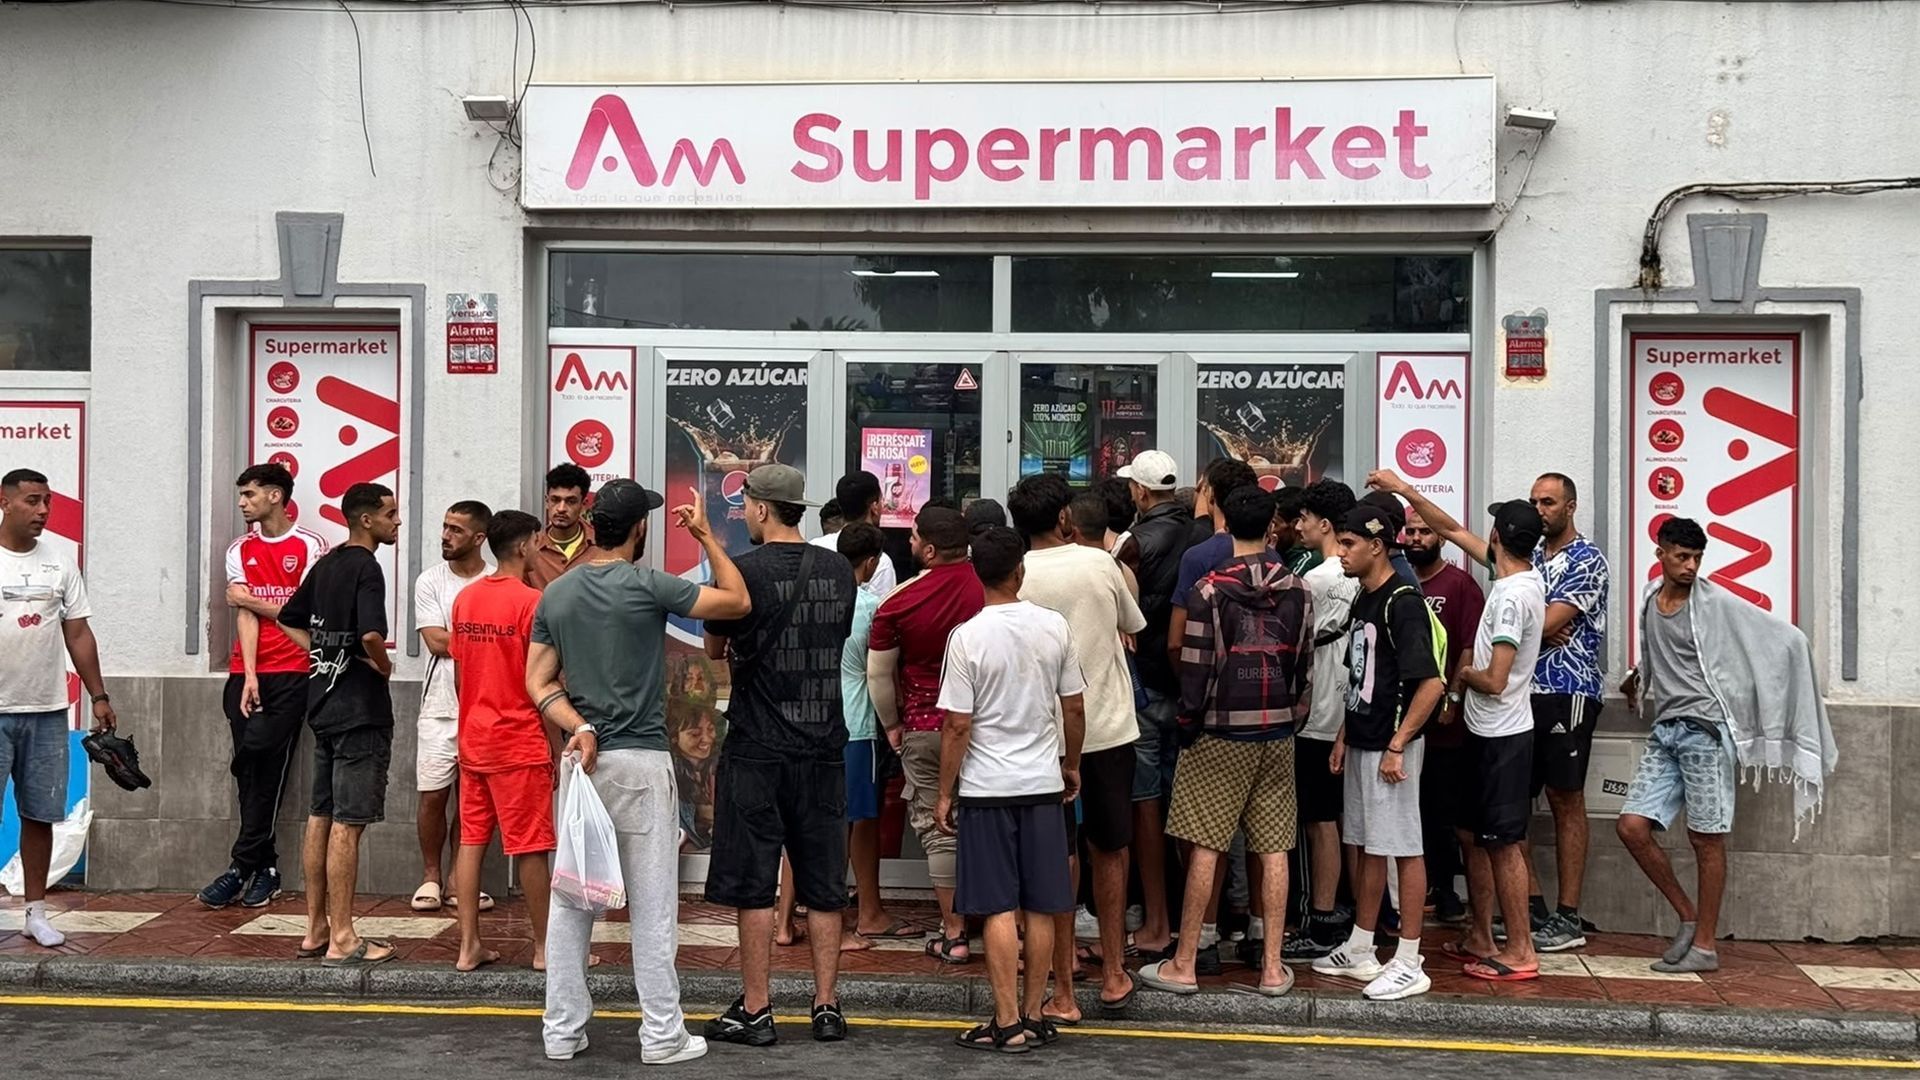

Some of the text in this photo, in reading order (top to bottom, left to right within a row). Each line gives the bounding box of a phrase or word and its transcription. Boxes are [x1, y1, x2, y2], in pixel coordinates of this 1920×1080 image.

[791, 106, 1432, 200] Supermarket
[450, 325, 494, 336] Alarma
[265, 338, 388, 357] Supermarket
[1647, 348, 1782, 367] Supermarket
[667, 362, 807, 386] ZERO AZÚCAR
[1197, 365, 1345, 389] ZERO AZÚCAR
[1033, 403, 1049, 412] ZERO
[1033, 413, 1082, 422] 100% MONSTER
[866, 447, 908, 460] EN ROSA!
[808, 579, 838, 600] ARE
[775, 648, 838, 671] AND THE
[780, 700, 831, 722] HEART
